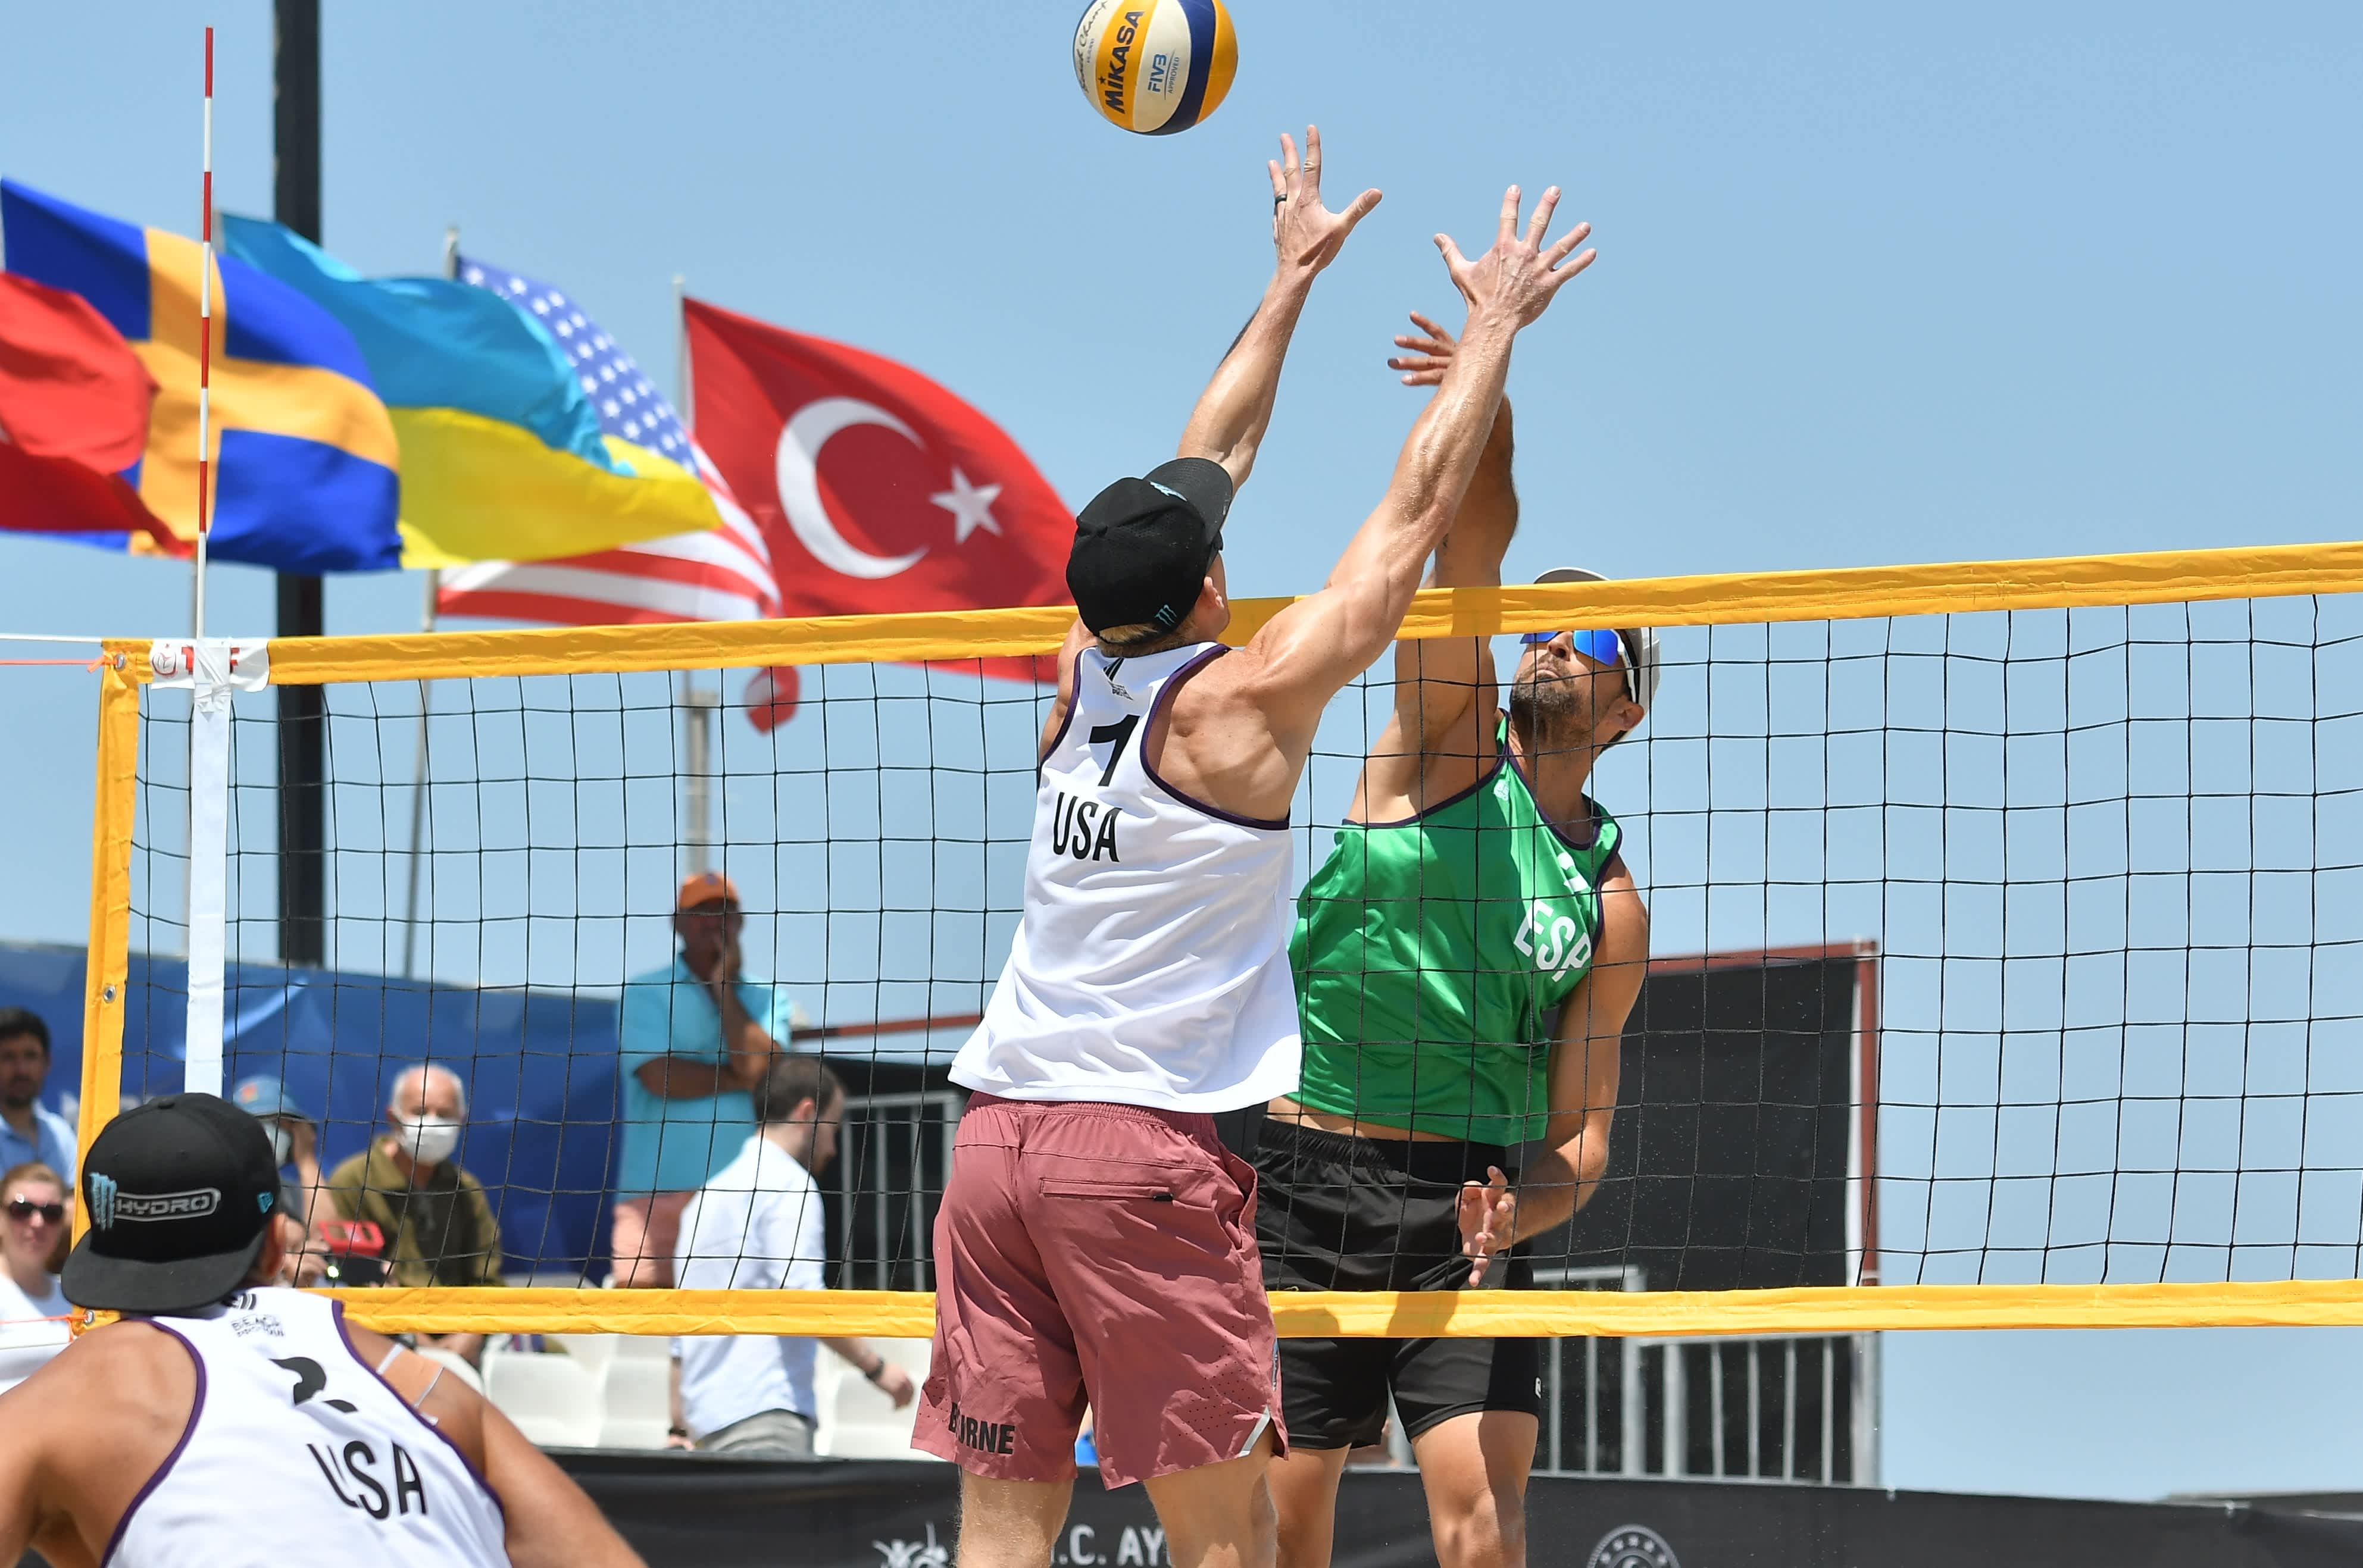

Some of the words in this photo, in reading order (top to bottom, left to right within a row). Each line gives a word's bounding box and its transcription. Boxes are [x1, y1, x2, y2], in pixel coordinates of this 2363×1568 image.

[1104, 11, 1145, 114] MIKASA
[1148, 54, 1167, 92] FIVB
[1168, 57, 1180, 93] APPROVED
[1053, 792, 1122, 862] USA
[1514, 899, 1592, 982] ESP
[118, 1195, 210, 1216] HYDRO
[268, 1357, 358, 1413] 2
[306, 1440, 427, 1520] USA
